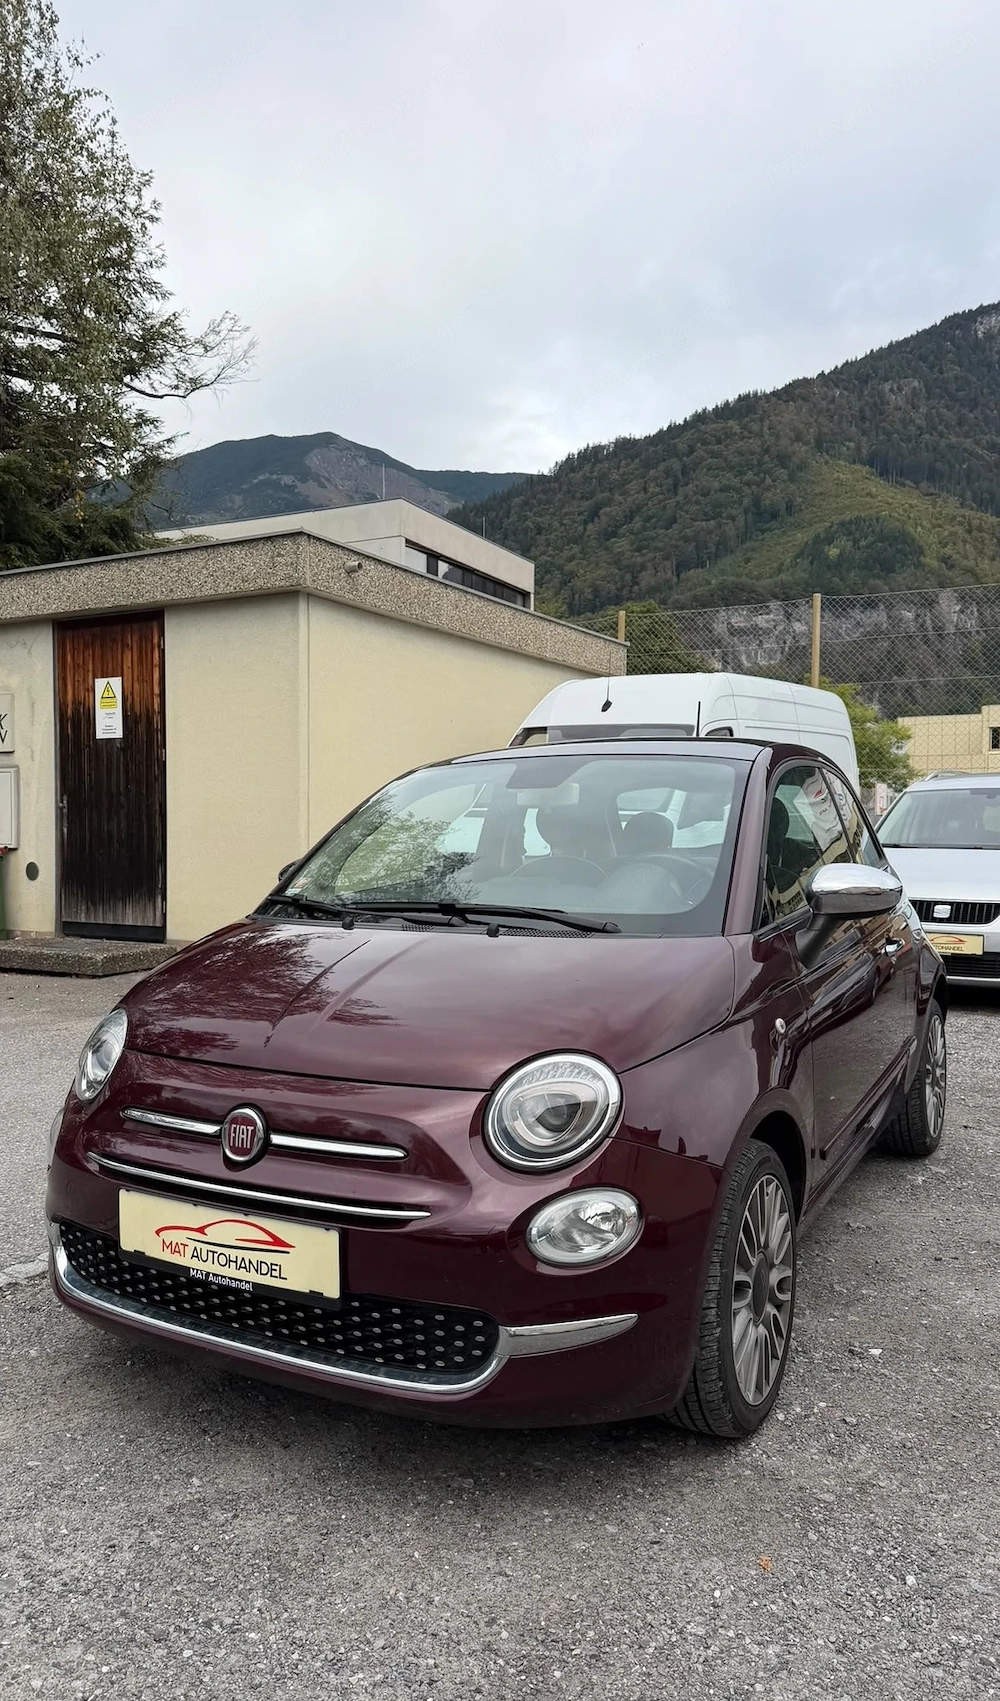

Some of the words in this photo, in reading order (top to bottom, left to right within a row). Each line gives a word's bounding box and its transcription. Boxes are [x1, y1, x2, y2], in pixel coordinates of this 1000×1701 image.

[933, 944, 965, 952] TOHANDEL
[229, 1123, 254, 1149] FIAT
[161, 1238, 189, 1258] MAT
[190, 1248, 288, 1281] AUTOHANDEL
[189, 1268, 207, 1281] MAT
[208, 1272, 253, 1291] Autohandel
